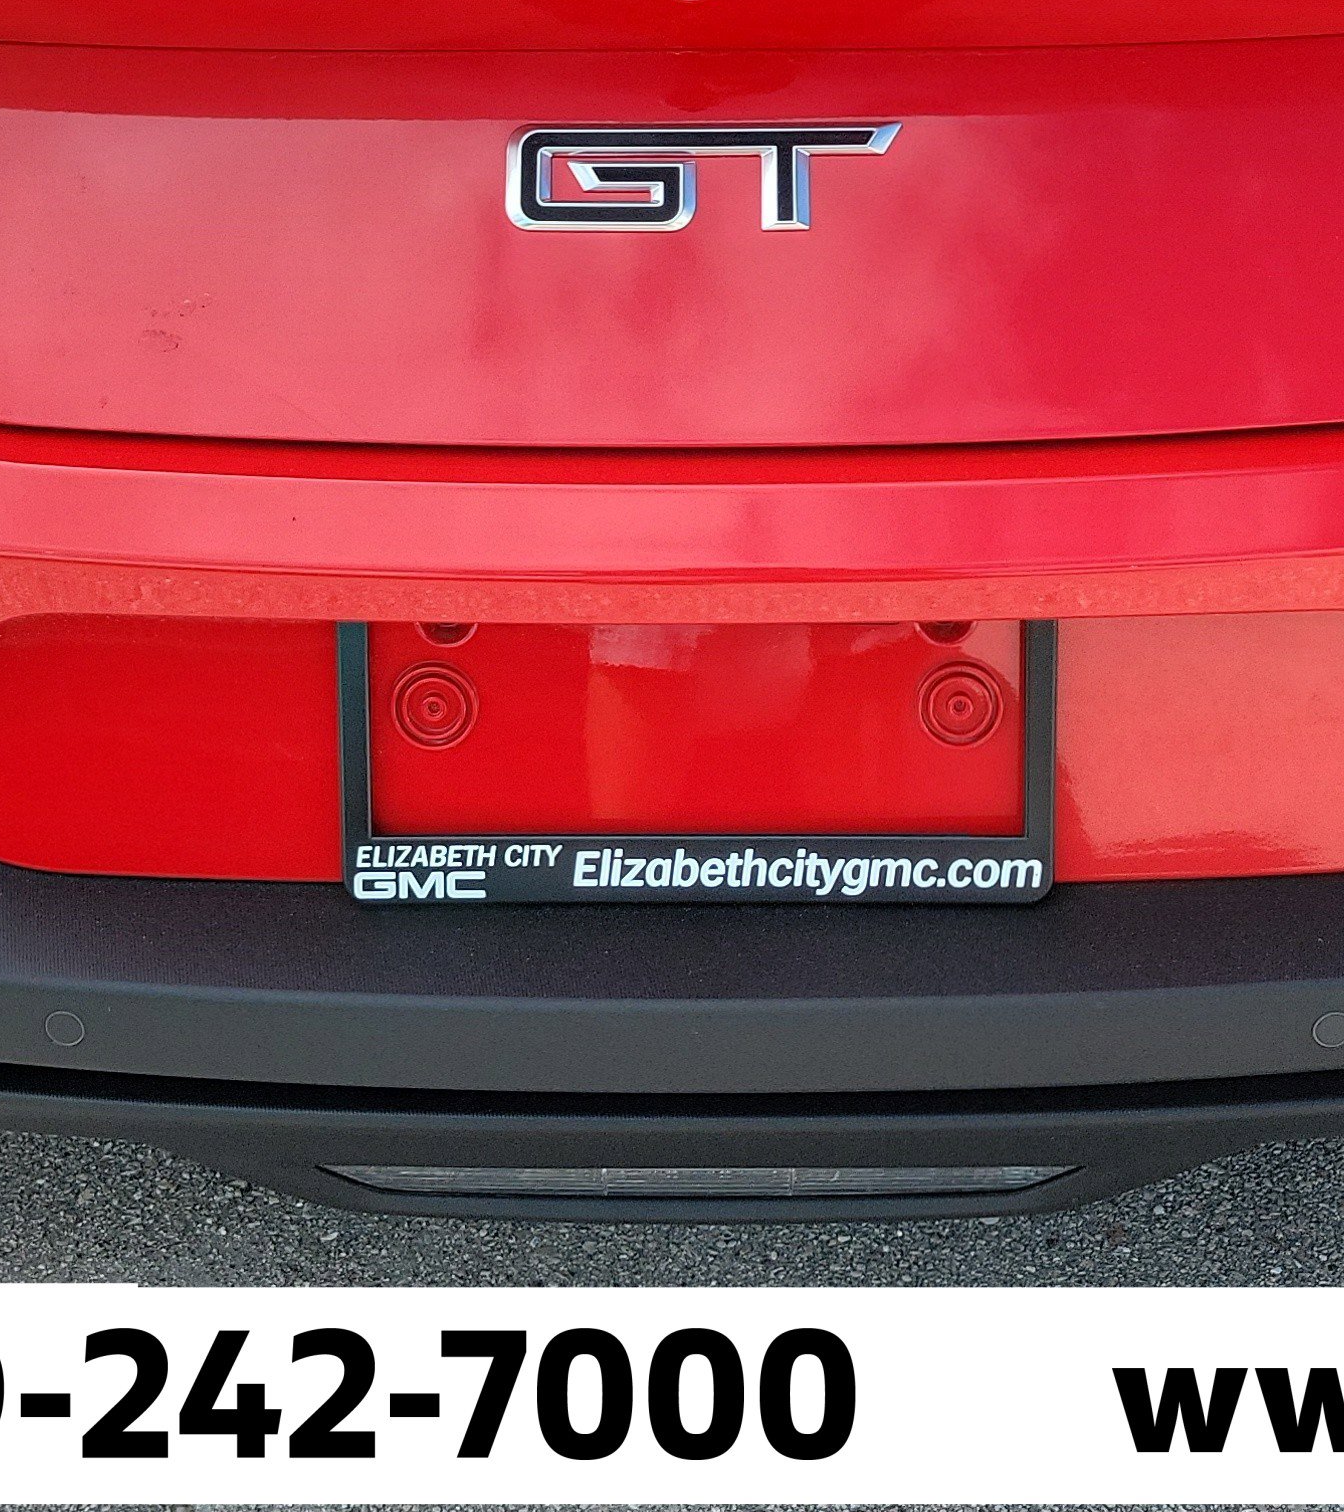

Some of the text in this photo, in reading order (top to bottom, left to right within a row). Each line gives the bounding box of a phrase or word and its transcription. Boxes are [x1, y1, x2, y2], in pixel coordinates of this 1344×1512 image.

[505, 122, 903, 232] GT
[356, 844, 563, 868] ELIZABETH CITY
[572, 849, 1043, 896] Elizabethcitygmc.com
[353, 870, 487, 900] GMC
